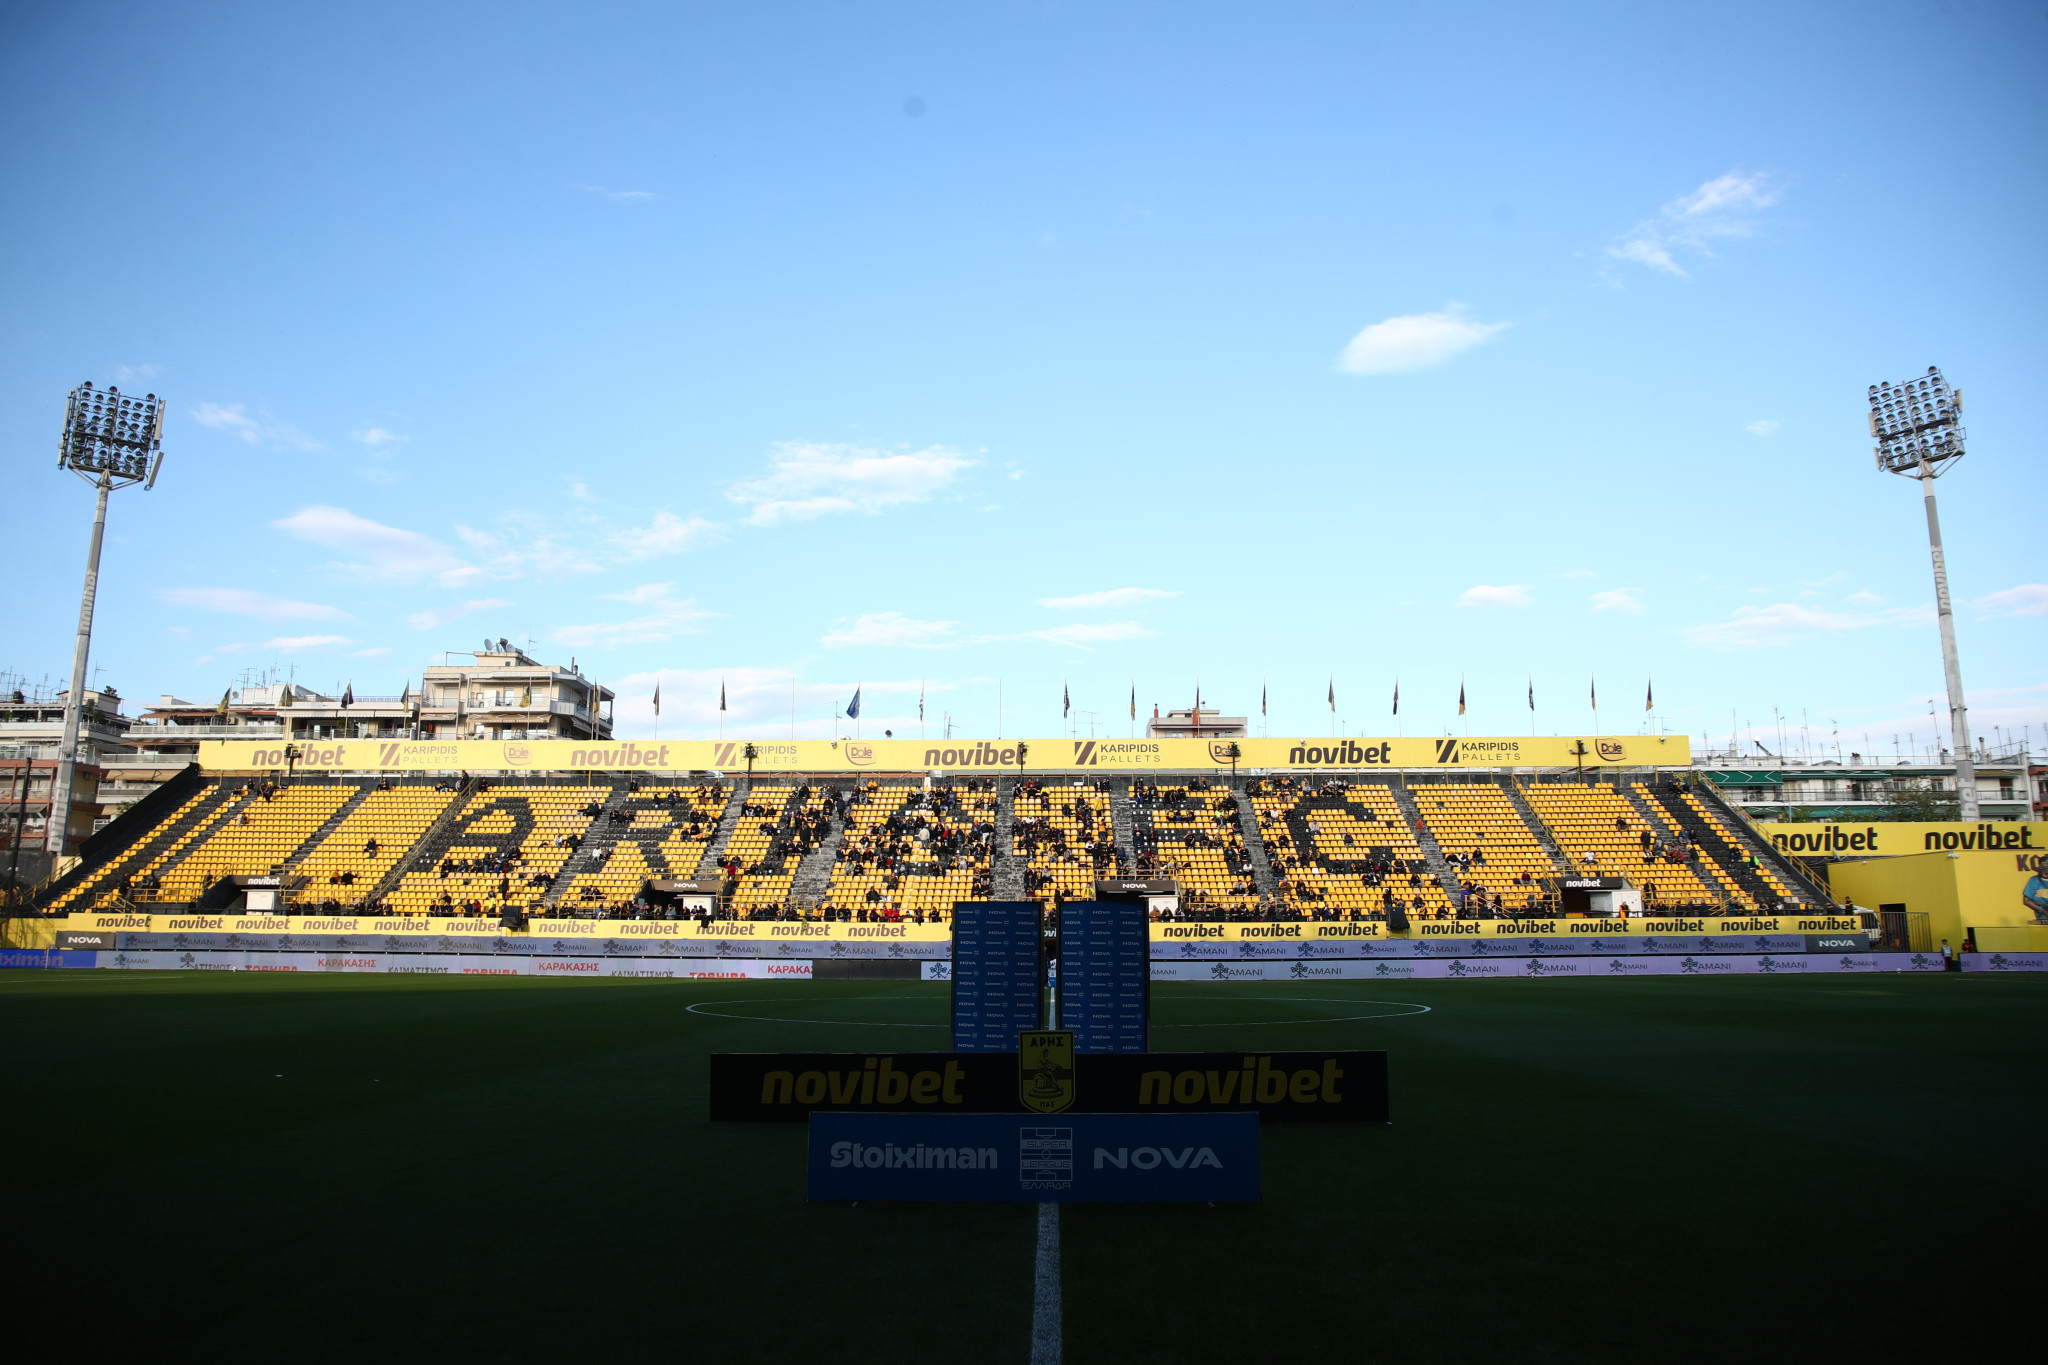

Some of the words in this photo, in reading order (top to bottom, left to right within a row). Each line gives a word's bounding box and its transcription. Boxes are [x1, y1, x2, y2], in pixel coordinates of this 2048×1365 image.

[404, 746, 458, 754] KARIPIDIS
[509, 748, 528, 756] Dole
[571, 743, 669, 766] novibet
[851, 747, 873, 757] Dole
[1101, 744, 1159, 753] KARIPIDIS
[1289, 740, 1391, 764] novibet
[1602, 743, 1622, 753] Dole
[1773, 826, 1878, 851] novibet
[1925, 824, 2032, 850] novibet
[1566, 879, 1600, 887] novibet
[97, 915, 151, 928] novibet
[170, 917, 223, 929] novibet
[236, 917, 290, 930] novibet
[303, 918, 358, 930] novibet
[374, 918, 430, 931] novibet
[446, 919, 502, 932] novibet
[539, 921, 596, 934] novibet
[620, 921, 679, 934] novibet
[1497, 921, 1556, 934] novibet
[1571, 920, 1629, 933] novibet
[1646, 920, 1704, 932] novibet
[1721, 918, 1779, 931] novibet
[1799, 918, 1856, 930] novibet
[696, 922, 755, 935] novibet
[771, 923, 830, 936] novibet
[848, 924, 906, 937] novibet
[1164, 924, 1224, 937] novibet
[1241, 924, 1301, 937] novibet
[1318, 923, 1378, 936] novibet
[1422, 922, 1480, 935] novibet
[318, 959, 376, 967] ΚΑΡΑΚΑΣΗΣ
[539, 962, 599, 971] ΚΑΡΑΚΑΣΗΣ
[1030, 1037, 1064, 1047] ΑΡΗΣ
[761, 1057, 966, 1104] novibet
[1139, 1056, 1343, 1105] novibet
[830, 1141, 998, 1170] Stoiximan
[1093, 1148, 1224, 1169] NOVA
